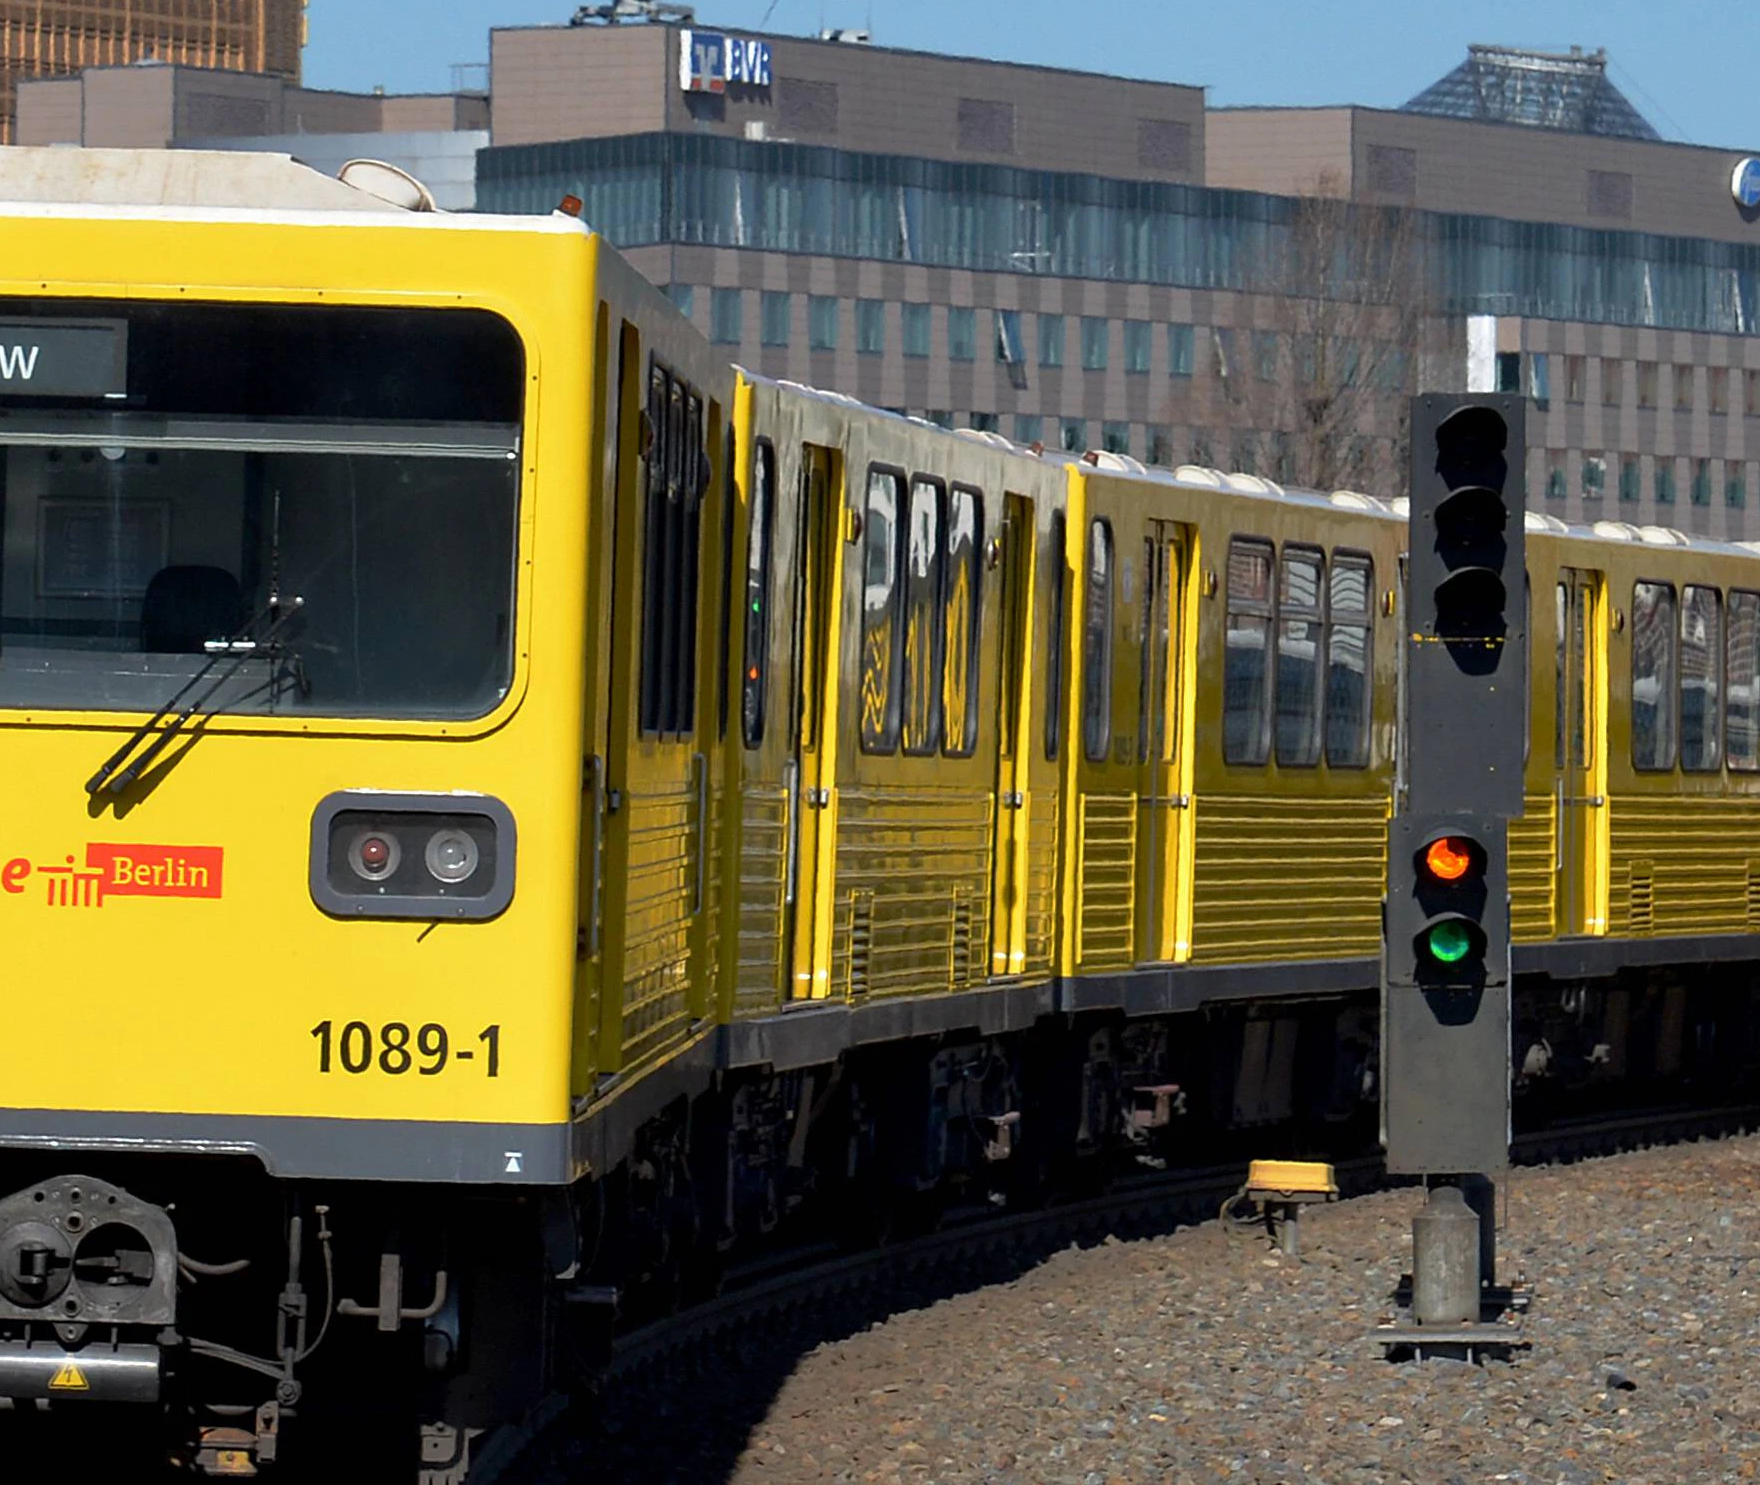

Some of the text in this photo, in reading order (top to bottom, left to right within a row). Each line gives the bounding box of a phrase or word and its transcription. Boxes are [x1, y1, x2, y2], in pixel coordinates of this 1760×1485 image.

[725, 38, 772, 85] BVR
[111, 857, 209, 888] Berlin
[310, 1020, 500, 1078] 1089-1
